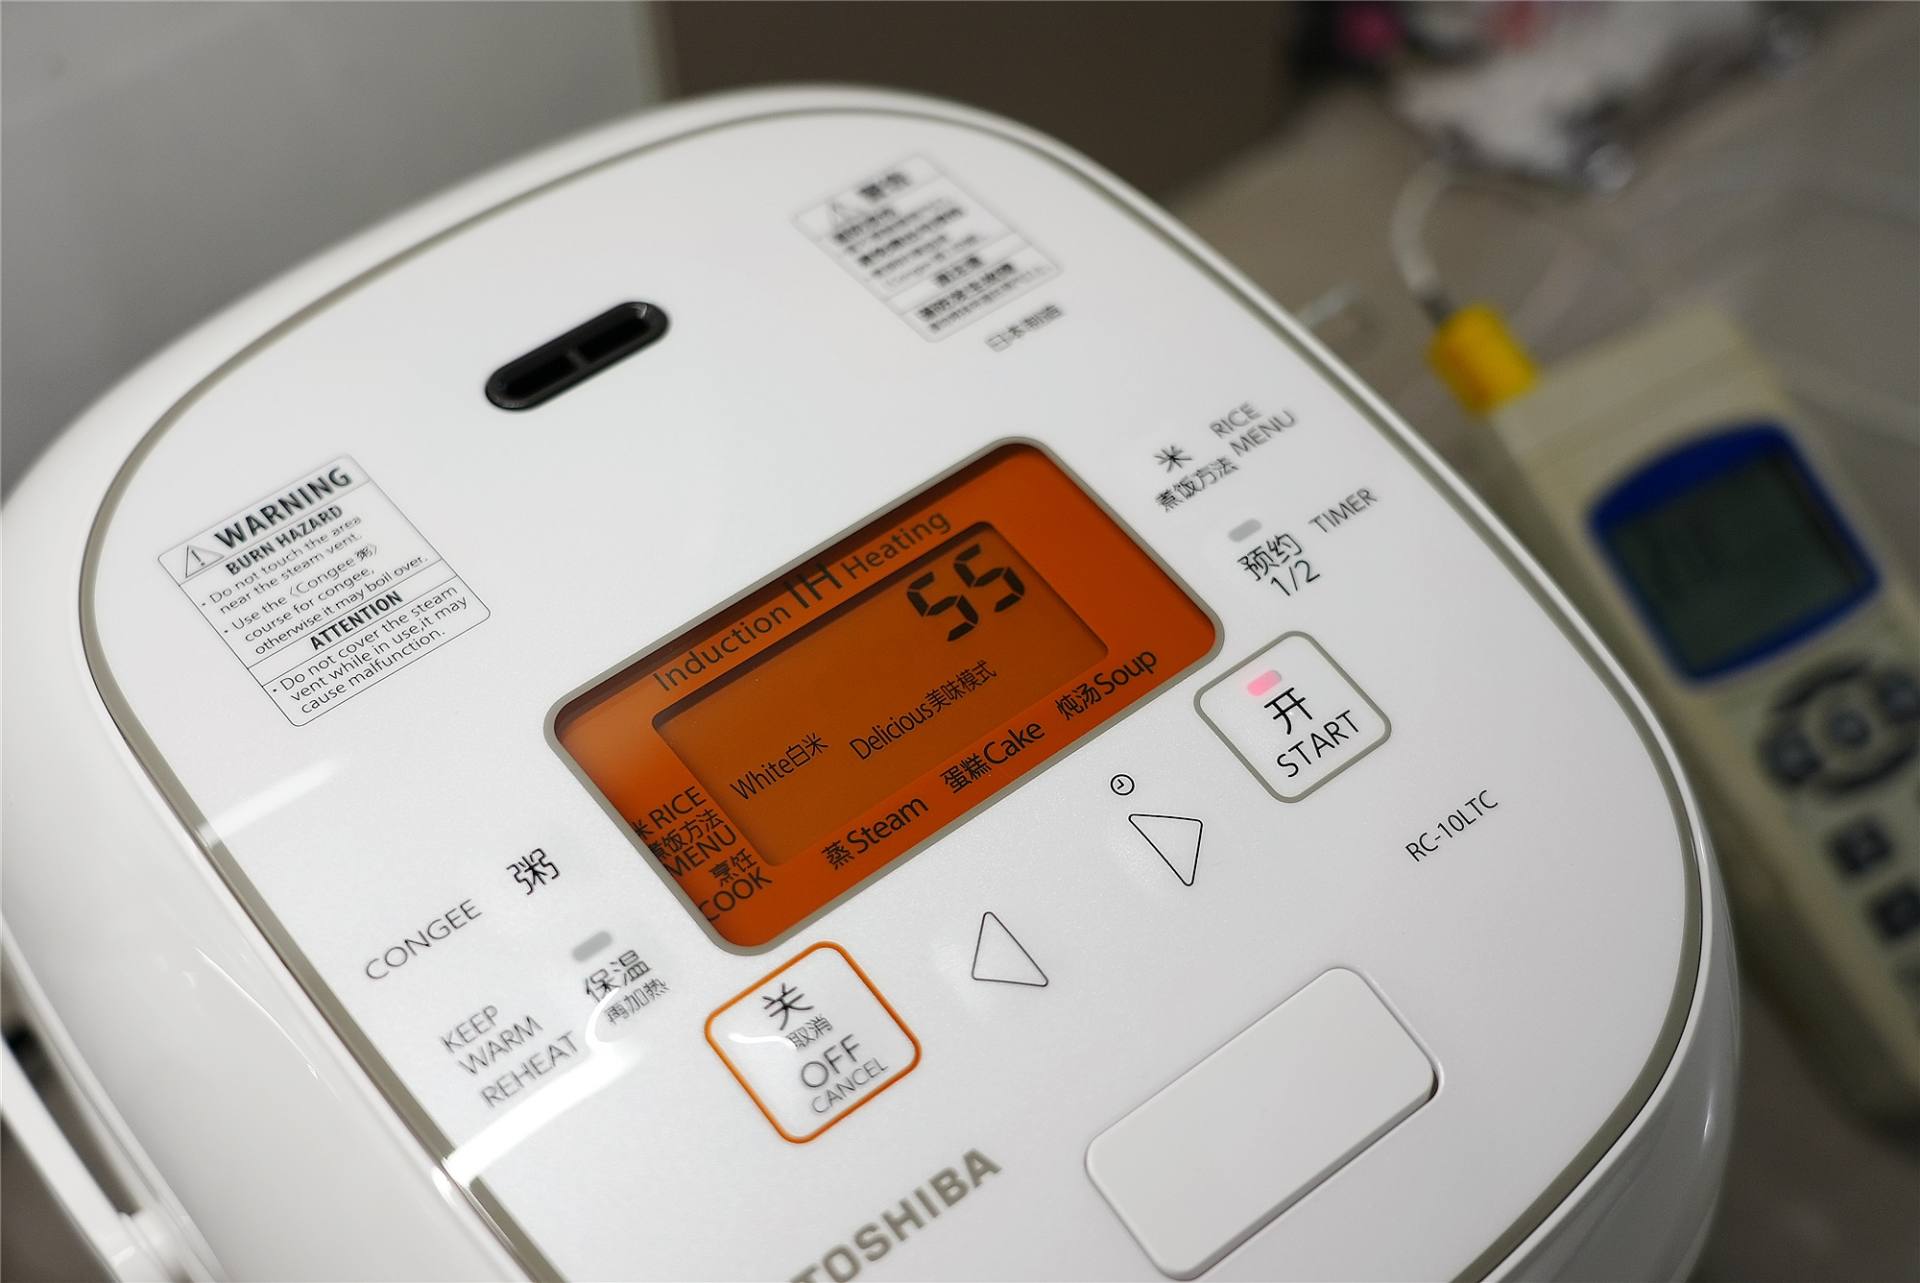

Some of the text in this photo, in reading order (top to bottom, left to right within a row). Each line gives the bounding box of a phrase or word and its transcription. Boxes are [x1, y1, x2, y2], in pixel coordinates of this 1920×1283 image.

[1209, 401, 1262, 439] RICE
[1229, 410, 1297, 457] MENU
[1153, 445, 1192, 473] 米
[1155, 456, 1239, 513] 煮饭方法
[213, 466, 353, 550] WARNING
[1308, 486, 1378, 534] TIMER
[209, 516, 362, 604] Do not touch the area
[225, 505, 343, 576] BURN HAZARD
[1237, 532, 1304, 582] 预约
[219, 592, 253, 614] near
[253, 575, 280, 595] the
[281, 552, 325, 581] steam
[255, 555, 429, 656] otherwise it may boil over.
[652, 511, 952, 692] Induction IH Heating
[906, 544, 1027, 642] 55
[1270, 559, 1321, 597] 1/2
[231, 610, 262, 631] Use
[262, 595, 288, 615] the
[244, 611, 292, 643] course
[293, 599, 315, 616] for
[280, 586, 459, 692] Do not cover the steam
[309, 590, 403, 651] ATTENTION
[290, 676, 329, 702] vent
[329, 650, 373, 681] while
[372, 640, 391, 656] in
[434, 596, 468, 621] may
[301, 630, 446, 715] cause malfunction.
[1094, 650, 1158, 696] Soup
[1264, 686, 1313, 735] 开
[983, 721, 1046, 766] Cake
[1276, 709, 1360, 778] START
[632, 785, 707, 841] 米 RICE
[821, 796, 930, 871] 蒸 Steam
[1405, 789, 1499, 862] RC-10LTC
[506, 847, 560, 895] 粥
[662, 823, 737, 878] MENU
[708, 847, 757, 888] 烹饪
[699, 866, 772, 923] COOK
[364, 898, 482, 982] CONGEE
[584, 949, 652, 1002] 保温
[604, 977, 671, 1025] 再加热
[439, 1004, 501, 1055] KEEP
[761, 982, 814, 1031] 关
[784, 1014, 834, 1051] 取消
[457, 1013, 544, 1076] WARM
[480, 1030, 580, 1110] REHEAT
[800, 1033, 861, 1088] OFF
[811, 1057, 888, 1114] CANCEL
